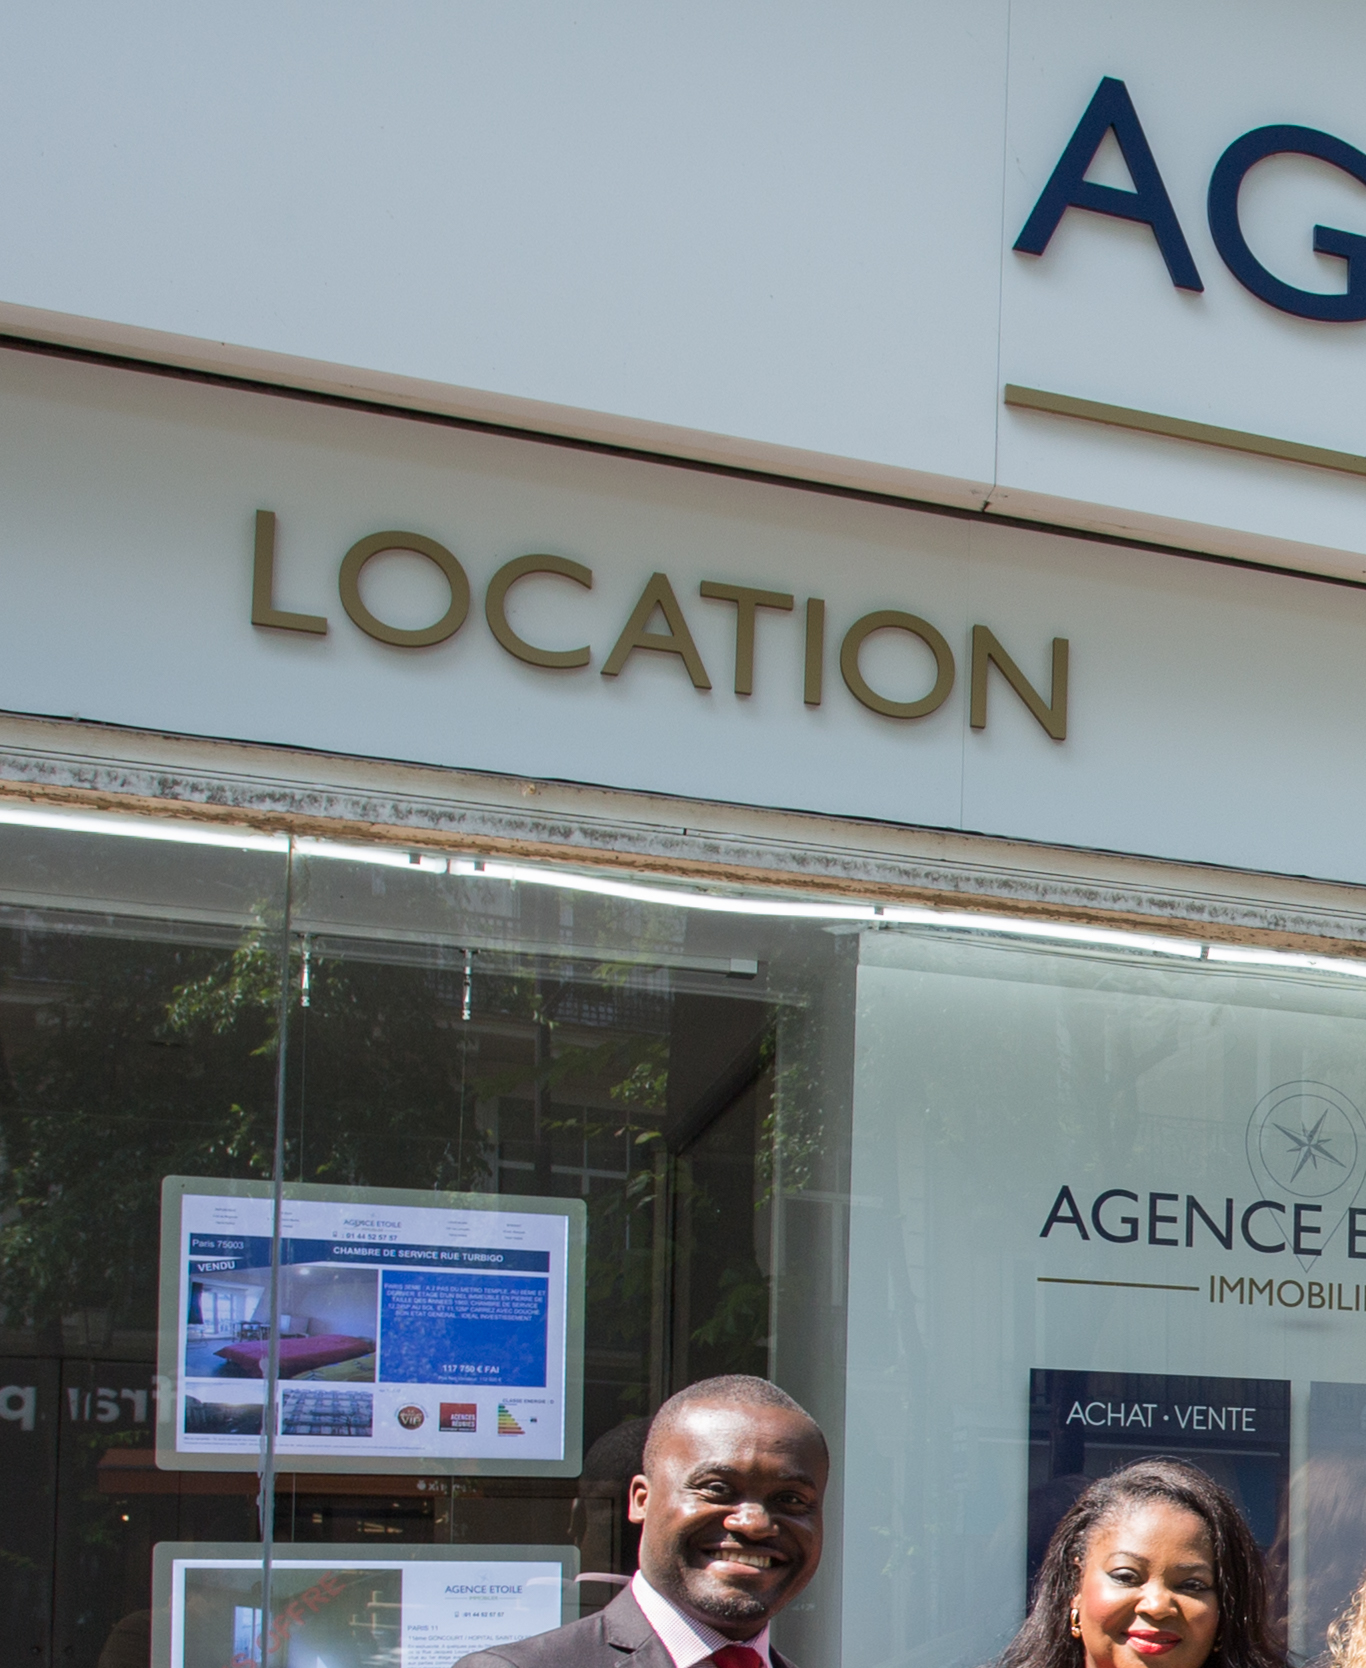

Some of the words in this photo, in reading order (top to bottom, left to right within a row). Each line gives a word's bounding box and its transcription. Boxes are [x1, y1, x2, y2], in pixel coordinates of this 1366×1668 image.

[250, 508, 1070, 742] LOCATION
[343, 1218, 375, 1228] AGENCE
[376, 1219, 401, 1229] ETOILE
[1037, 1184, 1324, 1257] AGENCE
[192, 1238, 215, 1249] Paris
[217, 1240, 244, 1250] 75003
[333, 1246, 381, 1257] CHAMBRE
[383, 1249, 396, 1257] DE
[398, 1250, 438, 1260] SERVICE
[440, 1252, 460, 1260] RUE
[463, 1253, 504, 1263] TURBIGO
[197, 1260, 236, 1273] VENDU
[442, 1364, 457, 1373] 117
[460, 1365, 475, 1373] 750
[484, 1365, 500, 1374] FAI
[1065, 1400, 1159, 1429] ACHAT
[1173, 1403, 1257, 1433] VENTE
[444, 1585, 487, 1594] AGENCE
[489, 1585, 523, 1594] ETOILE
[256, 1570, 347, 1654] OFFRE
